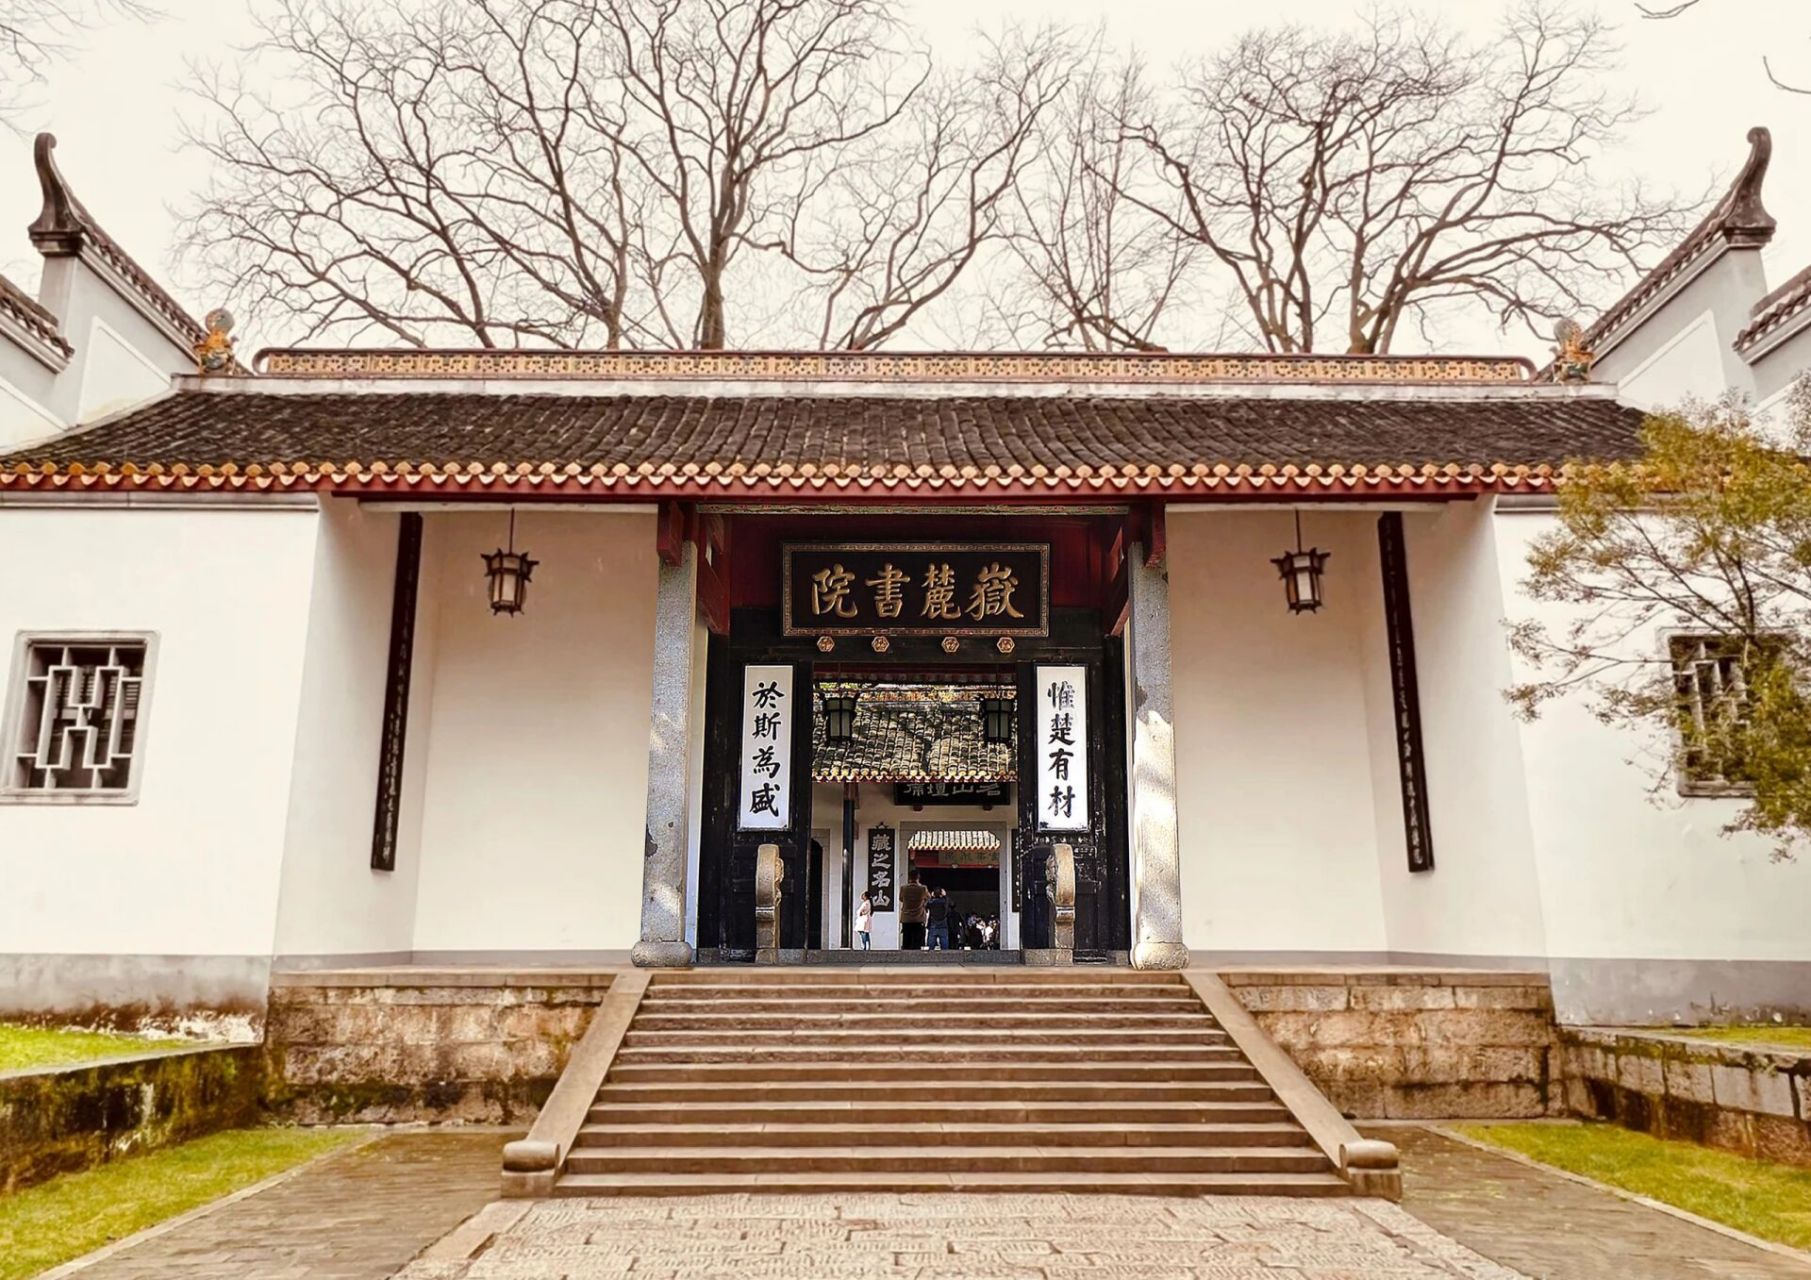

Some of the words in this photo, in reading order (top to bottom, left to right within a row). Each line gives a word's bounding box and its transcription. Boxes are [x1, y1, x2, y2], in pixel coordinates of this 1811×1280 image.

[811, 561, 1025, 621] 嶽麓書院
[1047, 681, 1076, 818] 惟楚有材
[871, 833, 892, 907] 藏之名山
